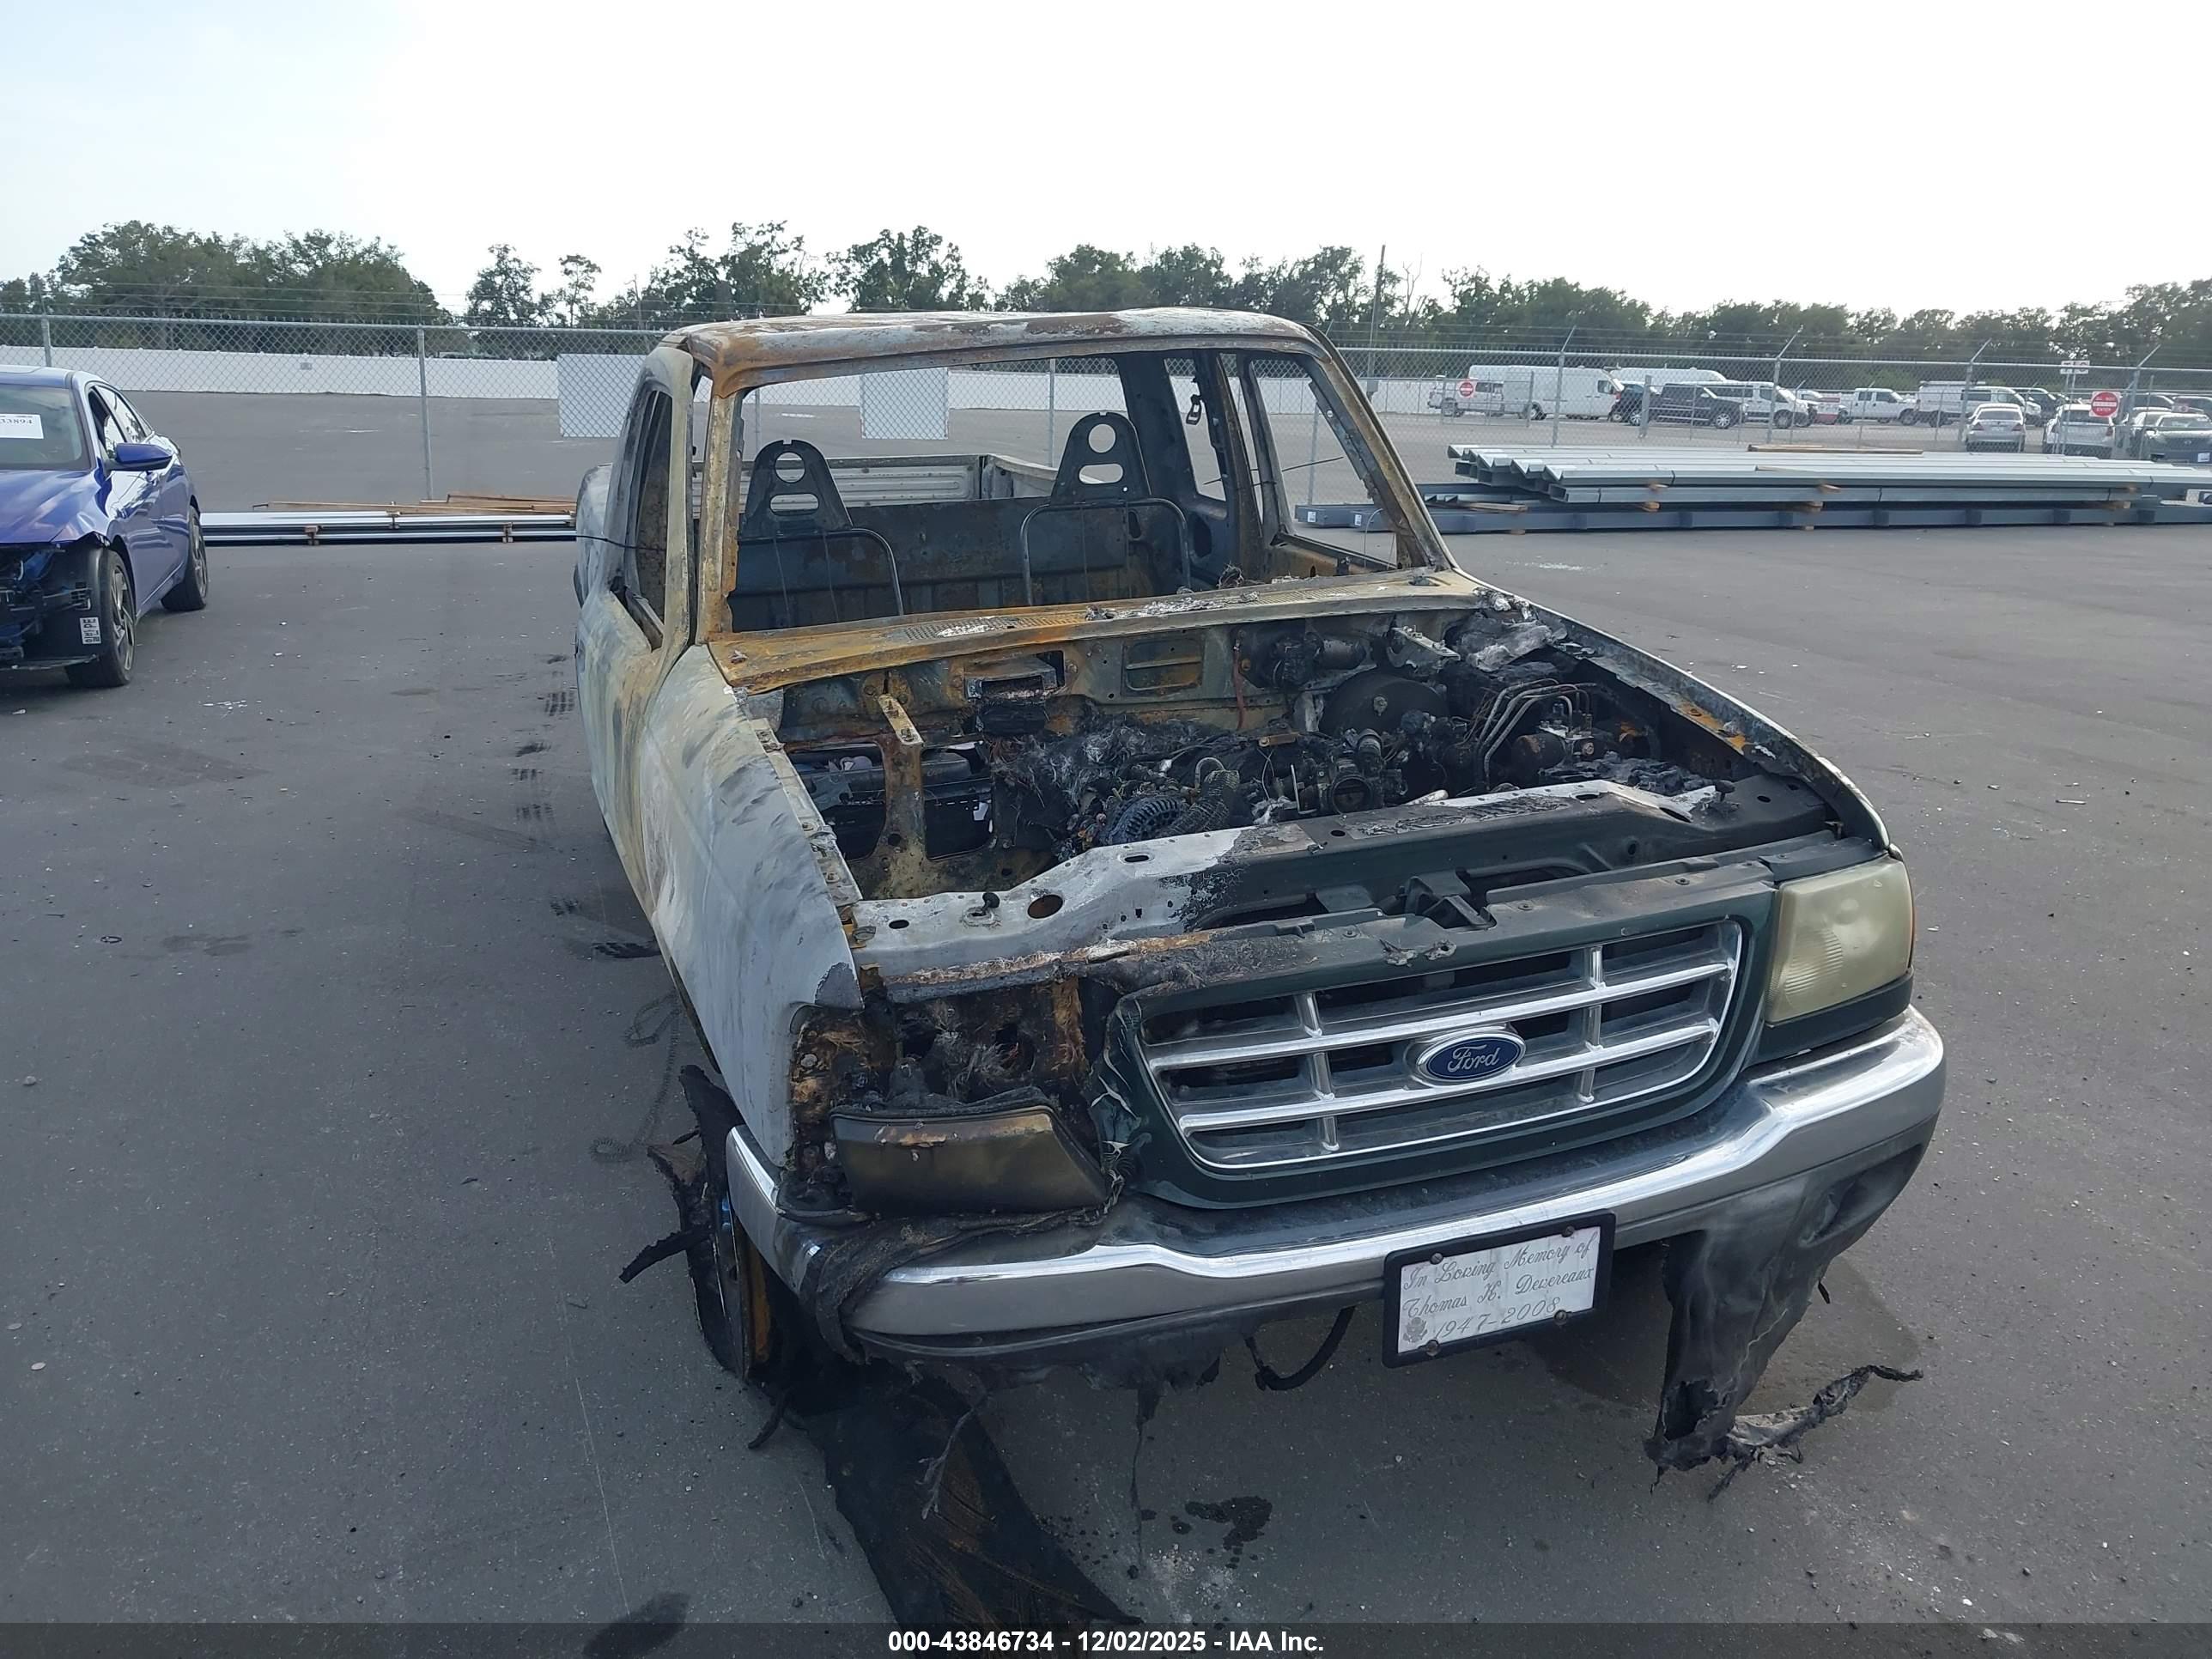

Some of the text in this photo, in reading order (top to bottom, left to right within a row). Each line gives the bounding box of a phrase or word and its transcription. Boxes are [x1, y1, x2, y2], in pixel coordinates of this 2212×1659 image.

[1447, 1044, 1501, 1073] Ford
[1403, 1231, 1599, 1291] In Loving Memory of
[1401, 1267, 1595, 1318] Thomas K. Devereaux
